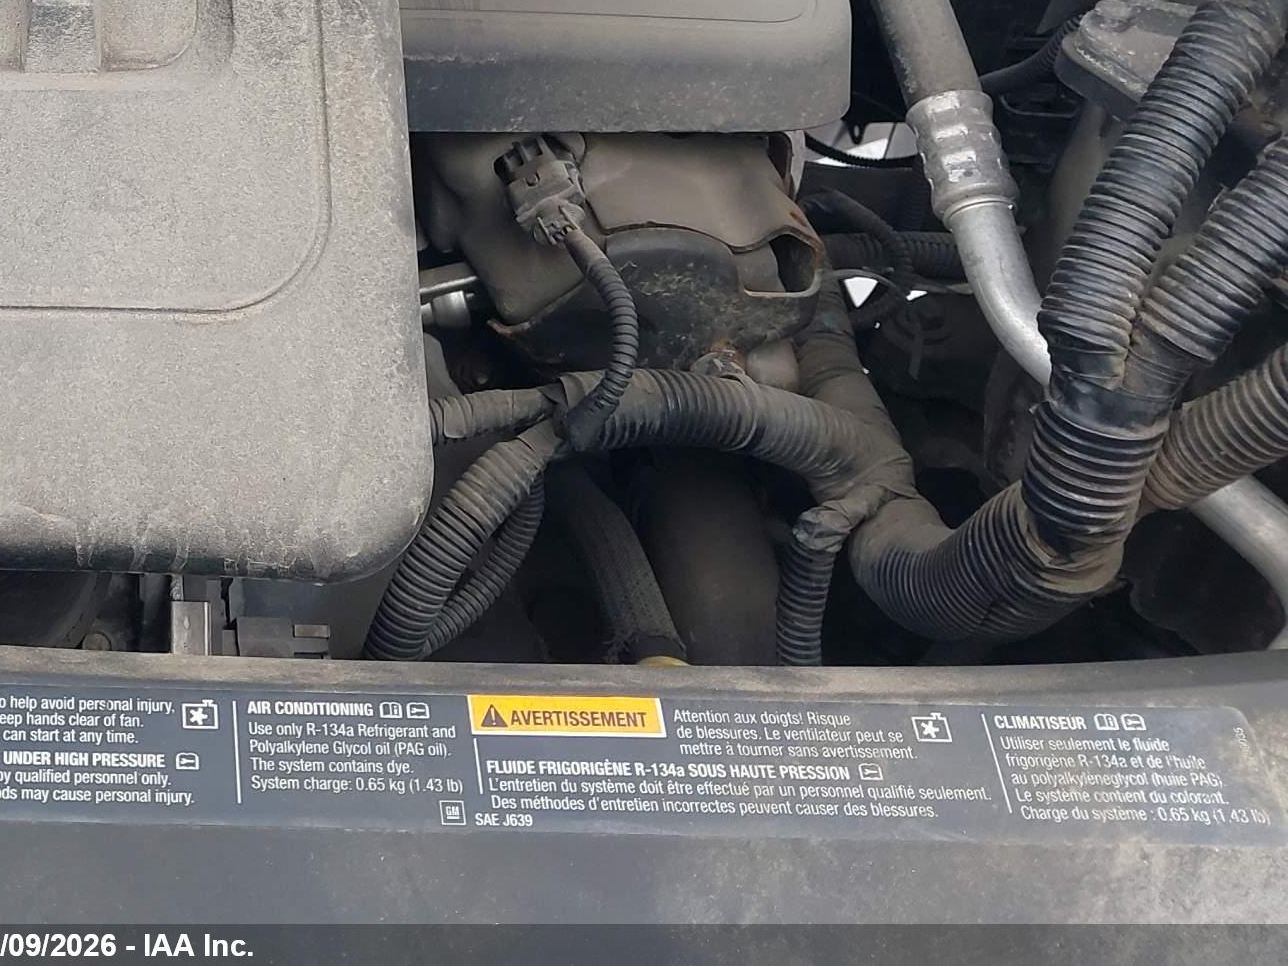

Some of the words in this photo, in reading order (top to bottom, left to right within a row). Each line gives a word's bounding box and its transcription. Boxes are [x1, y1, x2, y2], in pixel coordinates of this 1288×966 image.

[10, 695, 37, 711] help
[41, 697, 75, 710] avoid
[79, 698, 132, 712] personal
[247, 701, 271, 714] AIR
[275, 701, 373, 716] CONDITIONING
[27, 713, 65, 726] hands
[69, 714, 100, 726] clear
[104, 714, 116, 726] of
[120, 714, 144, 727] fan.
[511, 710, 647, 727] AVERTISSEMENT
[674, 709, 730, 723] Attention
[734, 713, 757, 724] aux
[761, 711, 803, 727] doigts!
[807, 712, 851, 728] Risque
[994, 715, 1087, 730] CLIMATISEUR
[3, 730, 26, 741] can
[30, 729, 59, 742] start
[63, 731, 76, 742] at
[80, 733, 102, 745] any
[107, 730, 139, 743] time.
[248, 722, 272, 734] Use
[277, 722, 302, 738] only
[307, 723, 353, 736] R-134a
[358, 723, 428, 741] Refrigerant
[433, 725, 456, 738] and
[677, 726, 693, 739] de
[696, 726, 762, 740] blessures.
[764, 727, 780, 741] Le
[784, 728, 851, 742] ventilateur
[855, 731, 885, 744] peut
[888, 732, 903, 743] se
[250, 739, 329, 755] Polyalkylene
[333, 741, 371, 757] Glycol
[375, 742, 390, 755] oil
[394, 742, 424, 757] (PAG
[428, 743, 452, 759] oil).
[680, 743, 722, 756] mettre
[726, 742, 734, 755] à
[737, 745, 783, 756] tourner
[788, 747, 818, 758] sans
[823, 744, 917, 759] avertissement.
[1000, 736, 1044, 750] Utiliser
[1049, 738, 1115, 751] seulement
[1118, 738, 1131, 751] le
[1134, 738, 1169, 751] fluide
[4, 751, 51, 765] UNDER
[55, 752, 88, 766] HIGH
[92, 753, 166, 768] PRESSURE
[250, 757, 275, 771] The
[278, 759, 325, 774] system
[329, 759, 383, 773] contains
[387, 759, 414, 776] dye.
[1006, 753, 1074, 770] frigorigène
[1078, 754, 1127, 768] R-134a
[1131, 755, 1144, 768] et
[1147, 755, 1162, 768] de
[487, 760, 536, 775] FLUIDE
[540, 759, 632, 776] FRIGORIGÈNE
[636, 763, 685, 777] R-134a
[689, 764, 726, 777] SOUS
[730, 765, 776, 778] HAUTE
[780, 766, 850, 780] PRESSION
[15, 769, 70, 783] qualified
[74, 771, 137, 785] personnel
[141, 772, 171, 788] only.
[252, 775, 299, 791] System
[304, 778, 352, 793] charge:
[356, 778, 385, 791] 0.65
[389, 778, 405, 794] kg
[410, 778, 443, 794] (1.43
[447, 779, 463, 794] lb)
[1011, 774, 1027, 784] au
[21, 788, 49, 803] may
[53, 789, 91, 801] cause
[95, 789, 151, 803] personal
[155, 789, 194, 806] injury.
[489, 778, 556, 792] L'entretien
[561, 779, 577, 793] du
[581, 780, 636, 795] système
[640, 780, 664, 794] doit
[668, 781, 693, 794] être
[697, 782, 749, 795] effectué
[754, 785, 774, 798] par
[779, 786, 795, 796] un
[799, 785, 863, 799] personnel
[868, 785, 913, 800] qualifié
[919, 787, 991, 800] seulement.
[1015, 789, 1032, 802] Le
[1036, 788, 1089, 804] système
[1094, 790, 1146, 802] contient
[1149, 791, 1167, 803] du
[1170, 791, 1229, 805] colorant.
[446, 807, 460, 815] GM
[491, 795, 516, 809] Des
[521, 796, 584, 810] méthodes
[589, 797, 658, 811] d'entretien
[663, 799, 735, 813] incorrectes
[740, 801, 792, 815] peuvent
[796, 803, 839, 815] causer
[844, 803, 867, 816] des
[871, 804, 938, 818] blessures.
[1021, 805, 1069, 822] Charge
[1072, 807, 1089, 819] du
[1093, 807, 1147, 822] système
[1158, 807, 1189, 821] 0.65
[1192, 809, 1211, 825] kg
[1213, 809, 1249, 824] (1.43
[475, 813, 500, 826] SAE
[503, 814, 532, 827] J639
